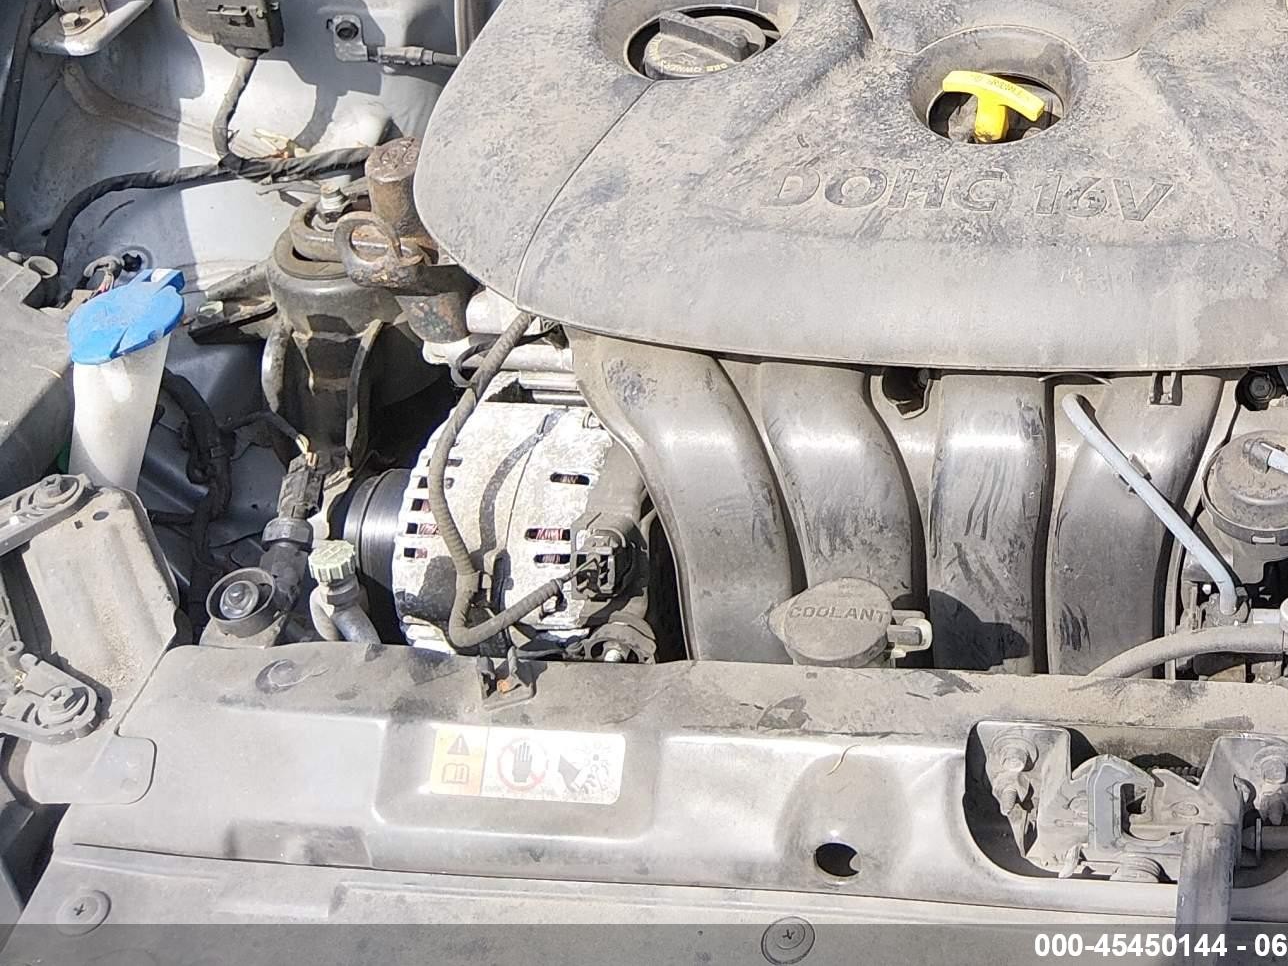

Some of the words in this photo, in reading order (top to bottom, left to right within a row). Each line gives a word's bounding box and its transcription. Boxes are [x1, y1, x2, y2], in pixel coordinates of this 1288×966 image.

[760, 166, 1013, 213] DOHC
[1033, 174, 1174, 222] 16V
[788, 605, 890, 624] COOLANT
